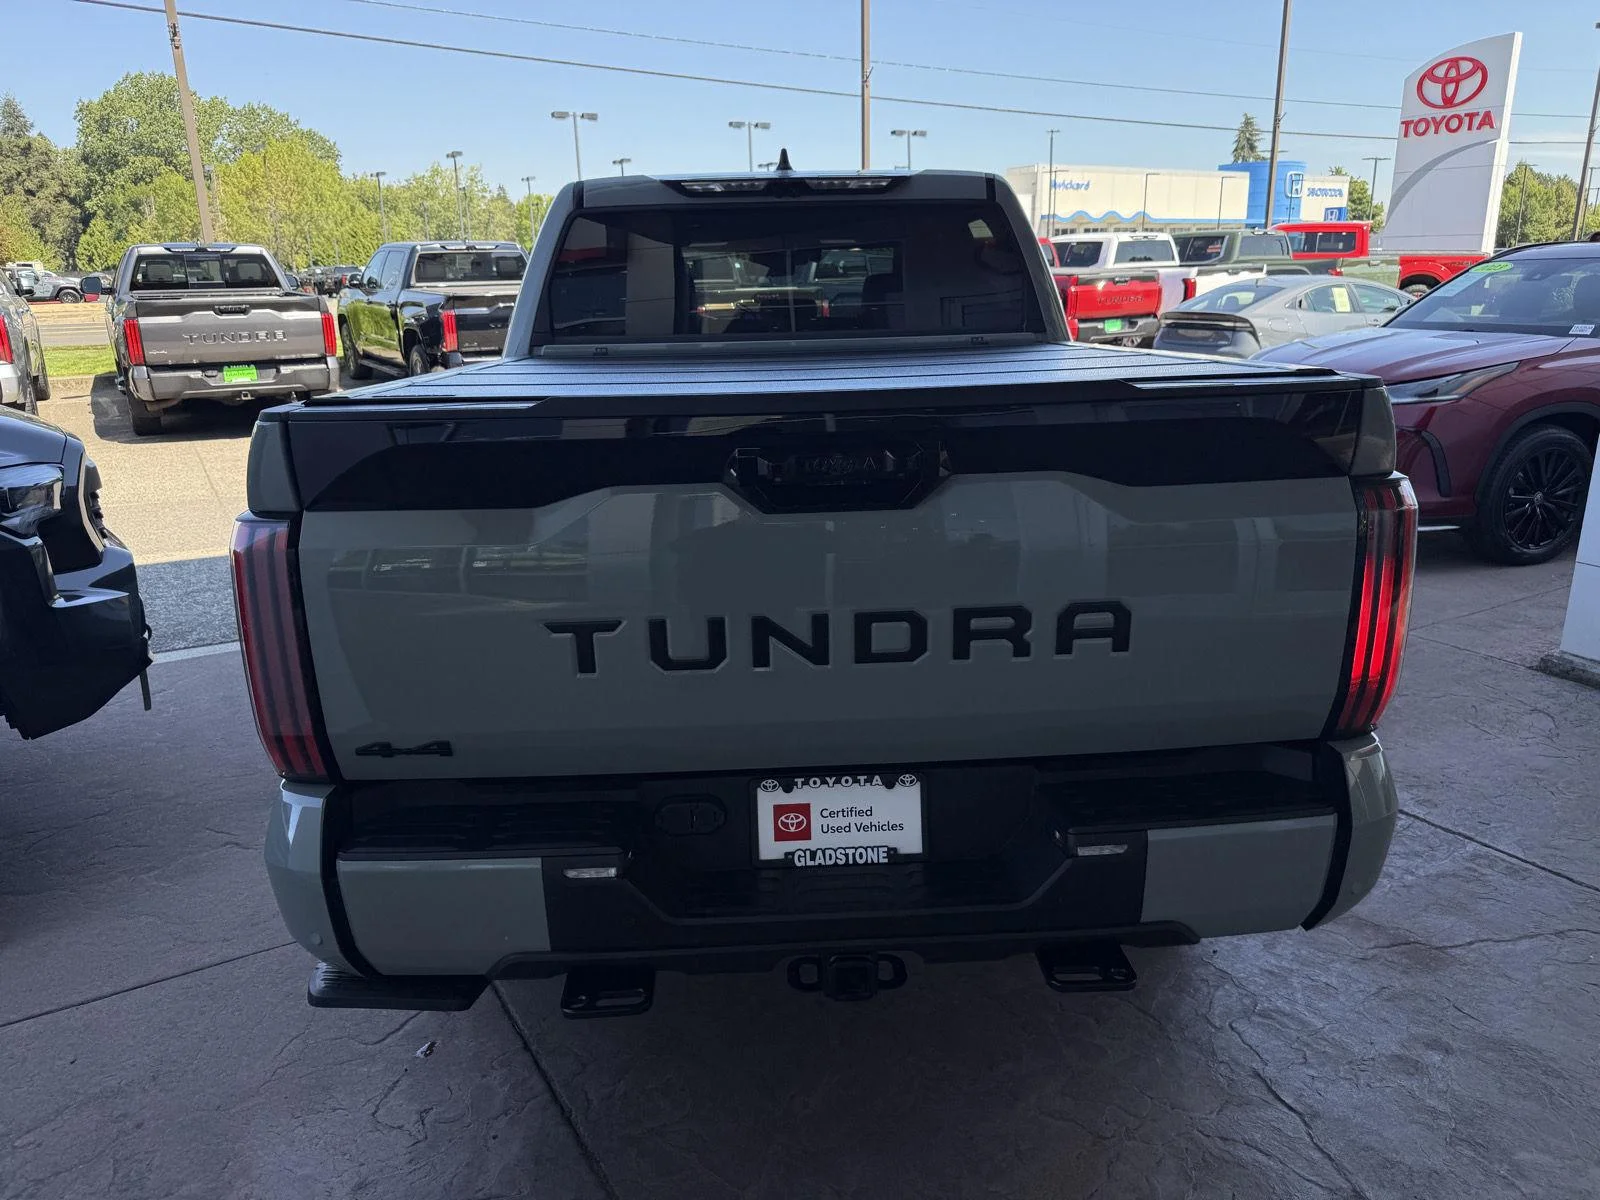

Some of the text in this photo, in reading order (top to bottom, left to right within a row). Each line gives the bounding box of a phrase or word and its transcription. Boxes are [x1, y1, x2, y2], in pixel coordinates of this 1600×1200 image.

[1400, 110, 1495, 138] TOYOTA
[182, 329, 287, 345] TUNDRA
[543, 600, 1132, 679] TUNDRA
[794, 775, 883, 789] TOYOTA
[820, 806, 873, 819] Certified
[820, 820, 904, 833] Used Vehicles
[793, 846, 889, 867] GLADSTONE
